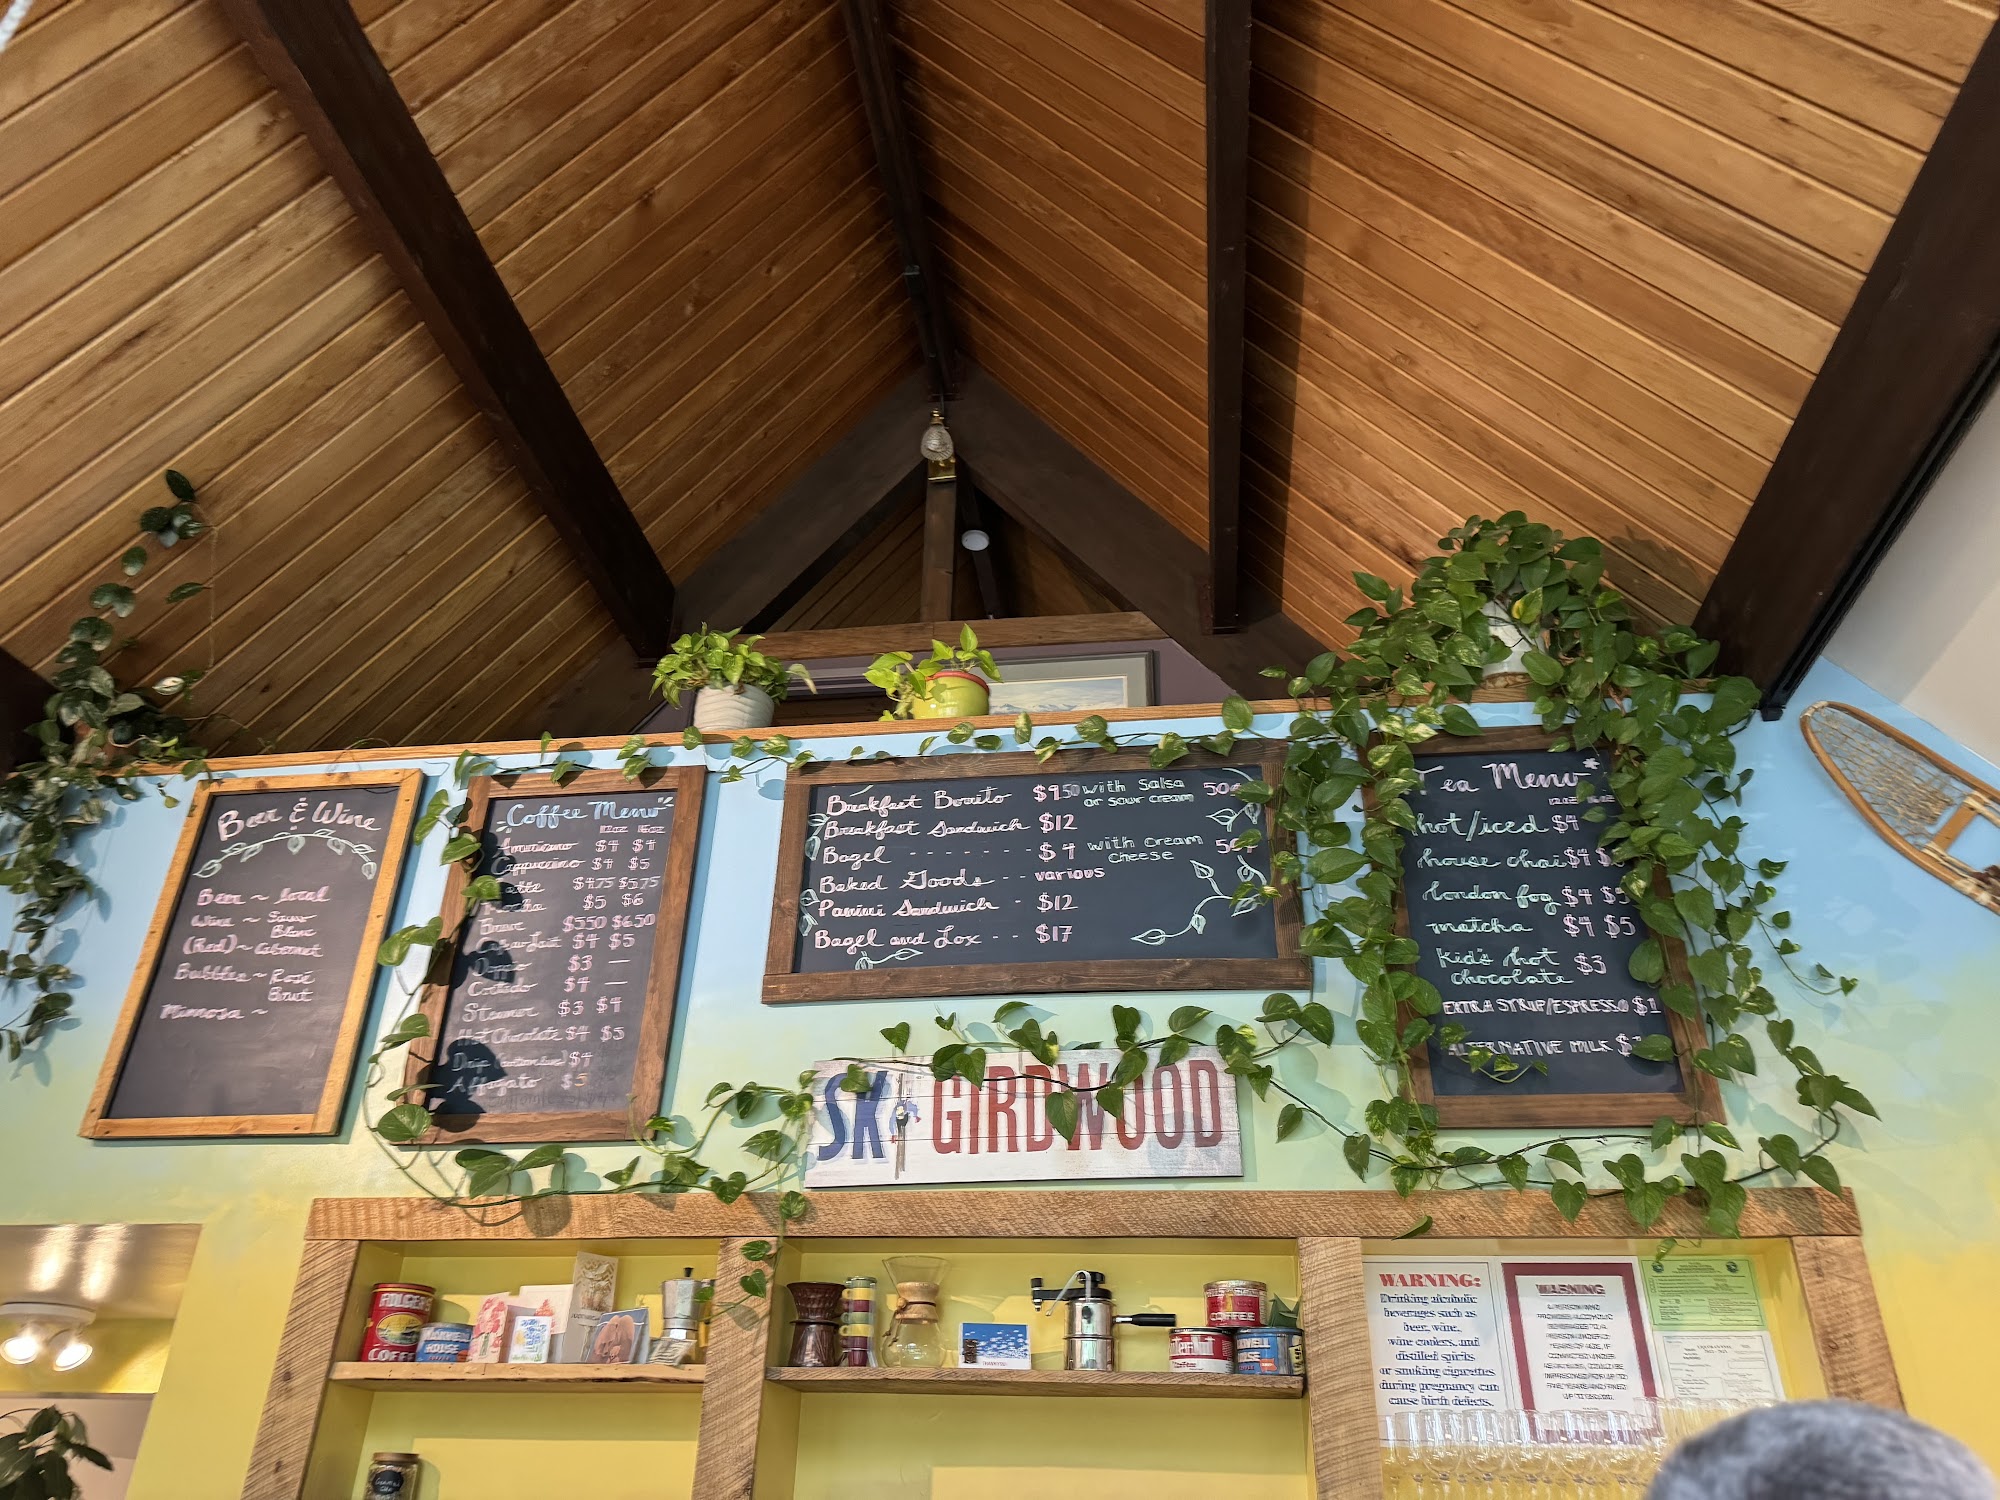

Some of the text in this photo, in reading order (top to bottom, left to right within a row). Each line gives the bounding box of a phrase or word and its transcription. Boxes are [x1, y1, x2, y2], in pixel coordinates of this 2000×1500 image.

[1482, 762, 1591, 790] Menu
[826, 794, 923, 817] Breakfast
[934, 787, 1012, 809] Burrito
[1082, 780, 1126, 795] with
[1138, 777, 1185, 791] Salsa
[1083, 793, 1195, 807] or sour cream
[218, 807, 282, 841] Beer
[311, 800, 382, 832] Wine
[506, 801, 663, 829] Coffee Menu
[823, 812, 1078, 840] Breakfast Sandwich $12
[1412, 810, 1579, 842] hot/iced $4
[494, 838, 656, 857] Americano $4 $4
[823, 846, 892, 870] Bagel
[1087, 836, 1135, 850] with
[491, 856, 650, 876] Cappuccino $4 $5
[1417, 848, 1501, 869] house
[1506, 848, 1567, 869] chai
[1564, 847, 1591, 868] $4
[496, 878, 545, 894] atte
[819, 867, 1106, 894] Baked Goods various
[197, 885, 330, 906] Beer local
[582, 894, 606, 911] $5
[621, 893, 644, 907] $6
[818, 892, 1078, 917] Panini Sandwich $12
[1515, 884, 1562, 916] fog
[1562, 886, 1592, 908] $4
[191, 915, 235, 927] Wine
[270, 924, 317, 938] Blanc
[1426, 914, 1636, 939] matcha $4 $5
[183, 934, 238, 955] (Red)
[572, 934, 600, 949] $4
[608, 932, 635, 950] $5
[814, 924, 1073, 954] Bagel and Lox $17
[472, 955, 592, 979] Doppio $3
[1503, 947, 1560, 967] hot
[1574, 953, 1607, 975] $3
[174, 962, 252, 982] Bubbles
[1451, 968, 1574, 985] chocolate
[268, 987, 313, 1002] Brut
[467, 976, 590, 996] Cortado $4
[159, 1003, 245, 1020] Mimosa
[462, 996, 622, 1022] Steamer $3 $4
[1442, 996, 1661, 1016] EXTRA SYRUP/ESPRESSO $1
[456, 1026, 625, 1046] Hot Chocolate $4 $5
[1569, 1040, 1613, 1053] MILK
[451, 1052, 491, 1074] Drip
[569, 1051, 593, 1068] $4
[446, 1072, 589, 1097] Affogato $5
[933, 1059, 1223, 1156] GIRDWOOD
[1379, 1273, 1482, 1288] WARNING:
[1536, 1284, 1606, 1295] WARNING
[1380, 1293, 1478, 1306] Drinking alcoholic
[1210, 1312, 1256, 1322] COFFEE
[1384, 1308, 1477, 1320] beverages such as
[1388, 1336, 1413, 1346] wine
[1459, 1336, 1480, 1347] and
[1396, 1351, 1476, 1364] distilled spirits
[1379, 1365, 1496, 1379] or smoking cigarettes
[1379, 1379, 1417, 1393] during
[1419, 1381, 1474, 1394] pregnancy
[1388, 1397, 1419, 1405] cause
[1421, 1395, 1450, 1406] birth
